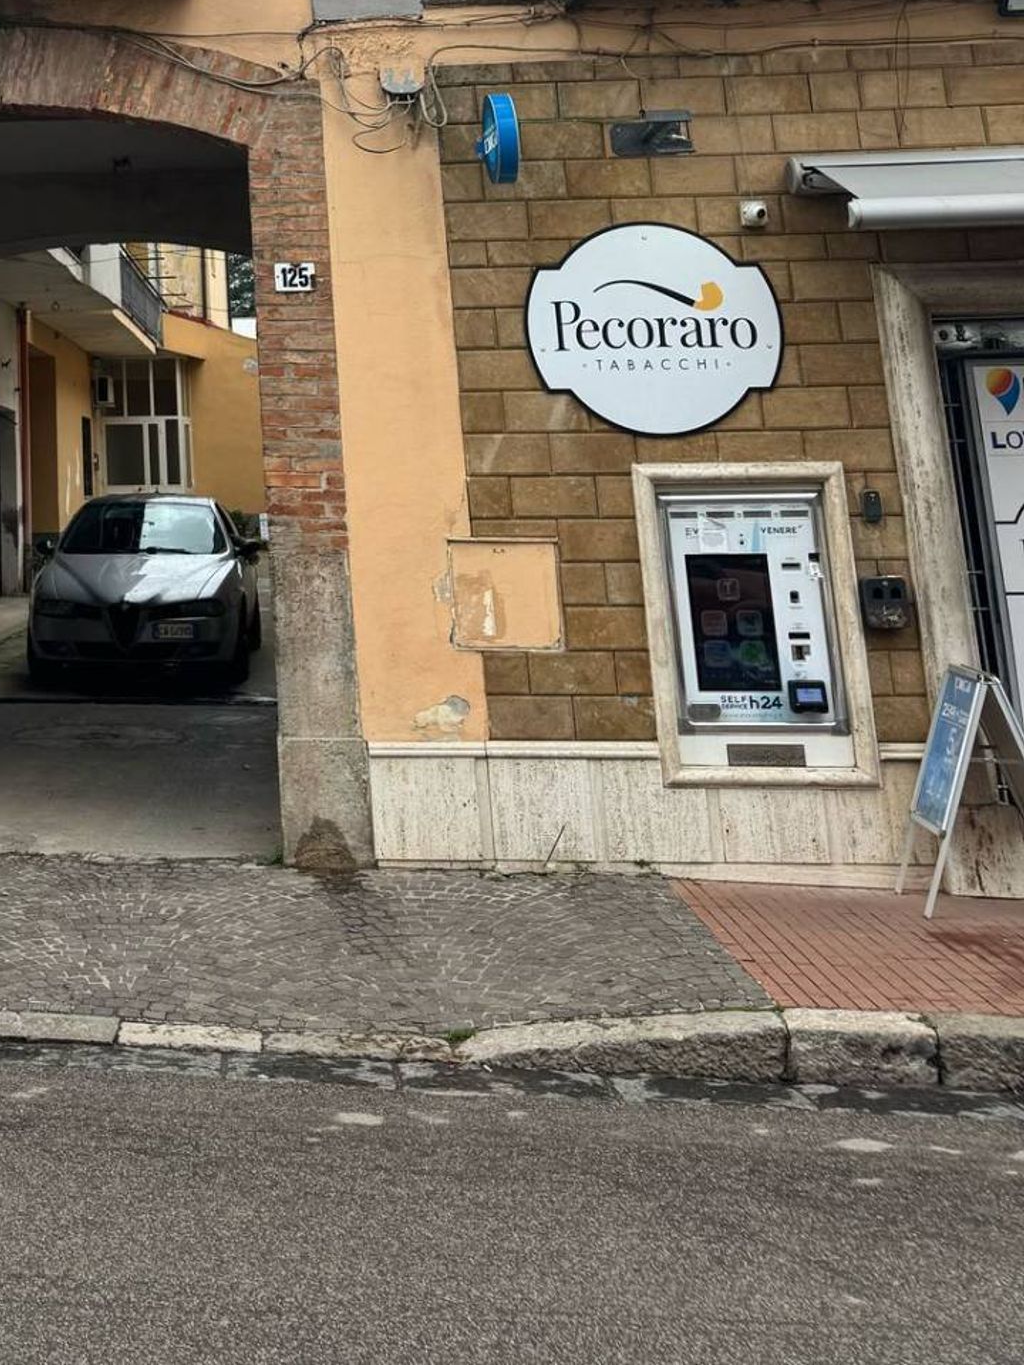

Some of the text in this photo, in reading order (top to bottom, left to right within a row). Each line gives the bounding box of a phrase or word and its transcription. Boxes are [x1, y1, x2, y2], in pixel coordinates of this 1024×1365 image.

[281, 267, 309, 287] 125
[550, 300, 758, 352] Pecoraro
[596, 358, 720, 372] TABACCHI
[990, 430, 1024, 449] LO
[720, 694, 783, 710] SELF h24
